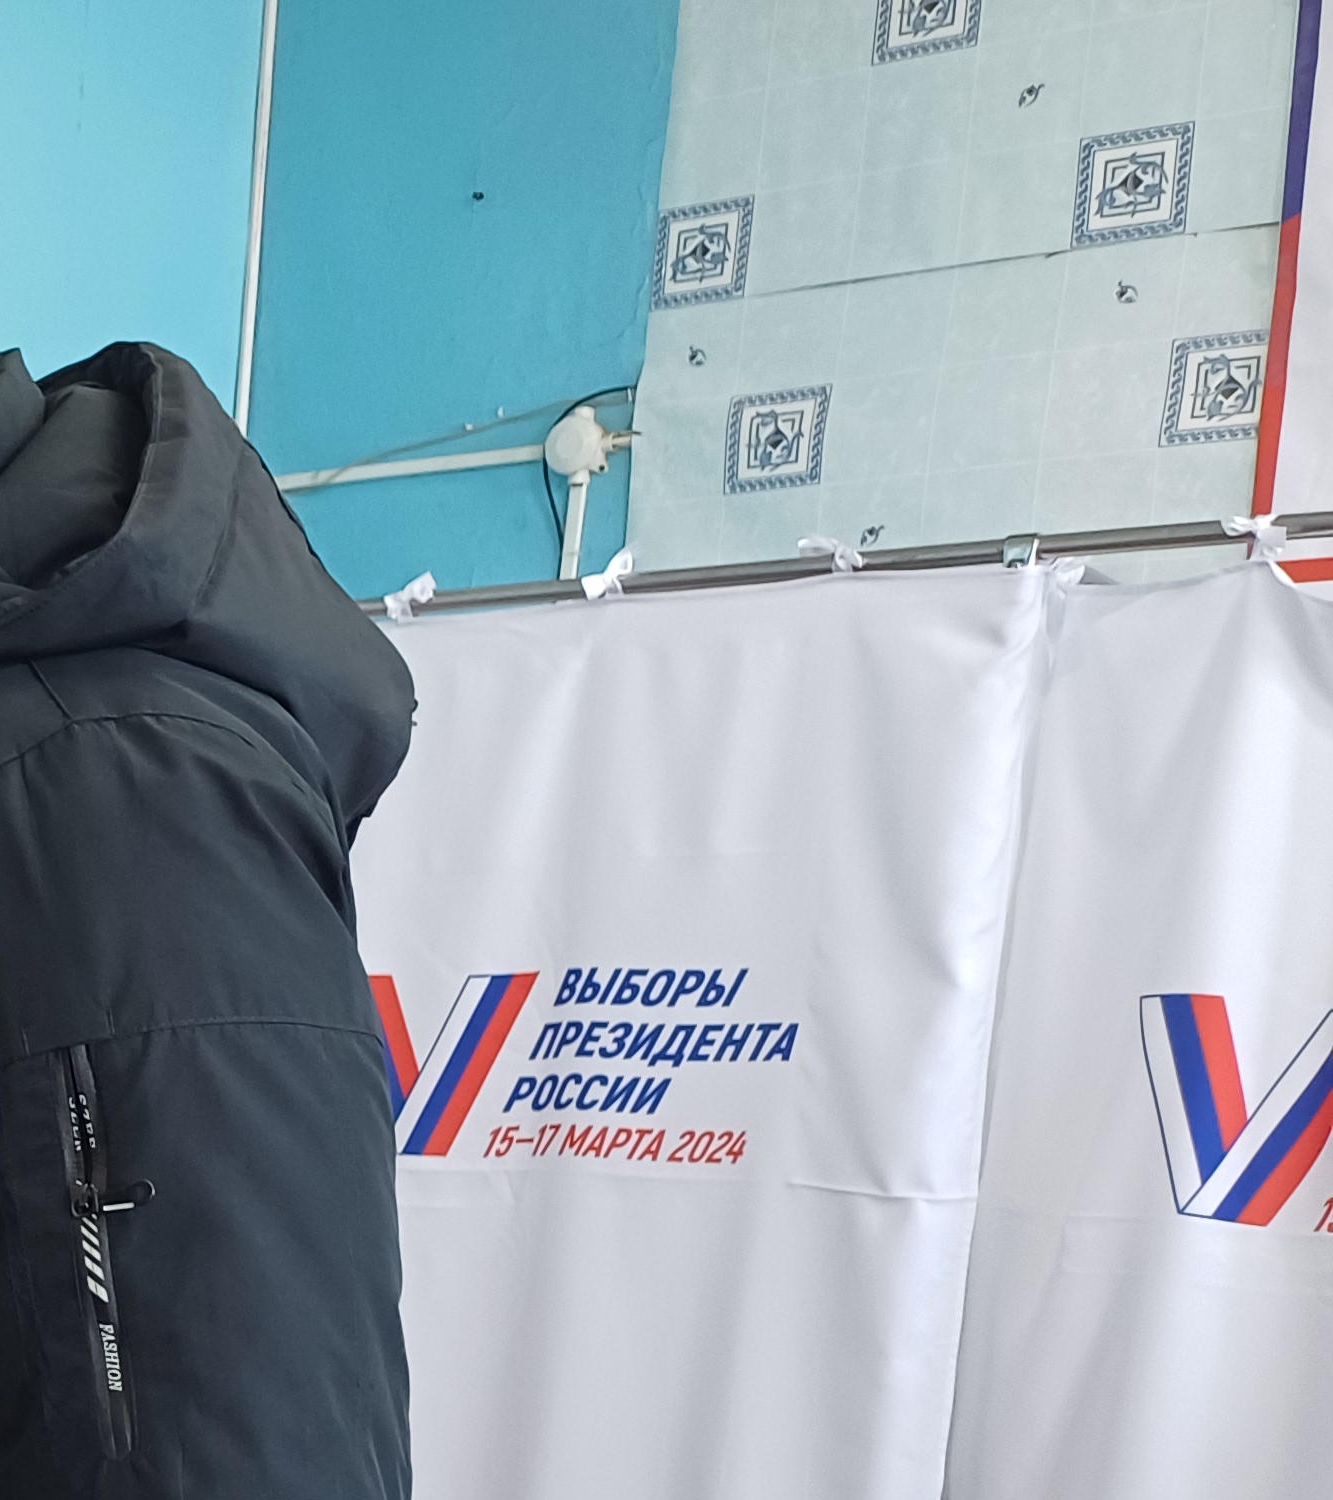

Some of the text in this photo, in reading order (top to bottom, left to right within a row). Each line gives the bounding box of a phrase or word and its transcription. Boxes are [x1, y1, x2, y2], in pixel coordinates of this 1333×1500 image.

[554, 967, 748, 1008] ВЫБОРЫ
[529, 1021, 799, 1067] ПРЕЗИДЕНТА
[502, 1074, 672, 1115] РОССИИ
[561, 1124, 666, 1162] МАРТА
[666, 1130, 748, 1165] 2024
[99, 1323, 123, 1393] FASHION
